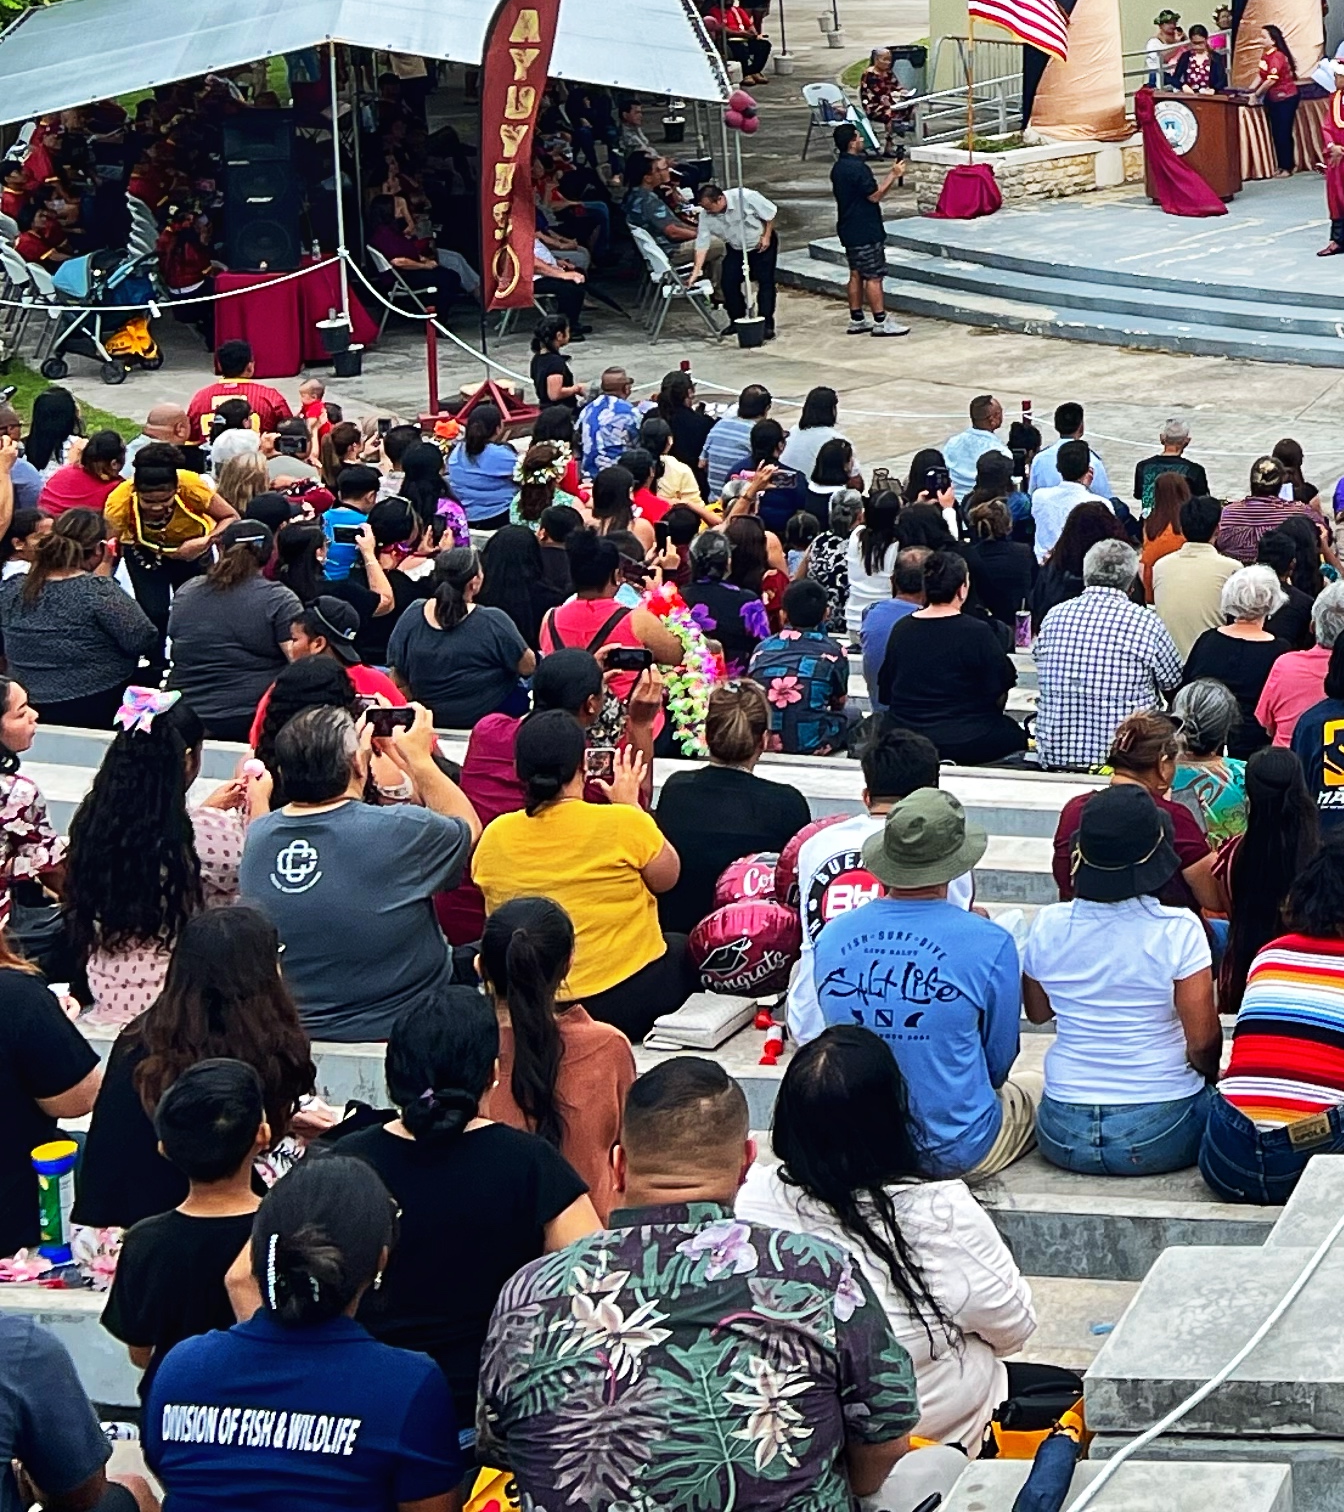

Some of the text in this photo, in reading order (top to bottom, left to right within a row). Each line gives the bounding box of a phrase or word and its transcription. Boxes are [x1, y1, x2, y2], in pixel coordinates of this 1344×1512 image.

[878, 930, 914, 942] SURF
[700, 948, 792, 992] Congrats
[162, 1404, 362, 1456] DIVISION OF FISH & WILDLIFE
